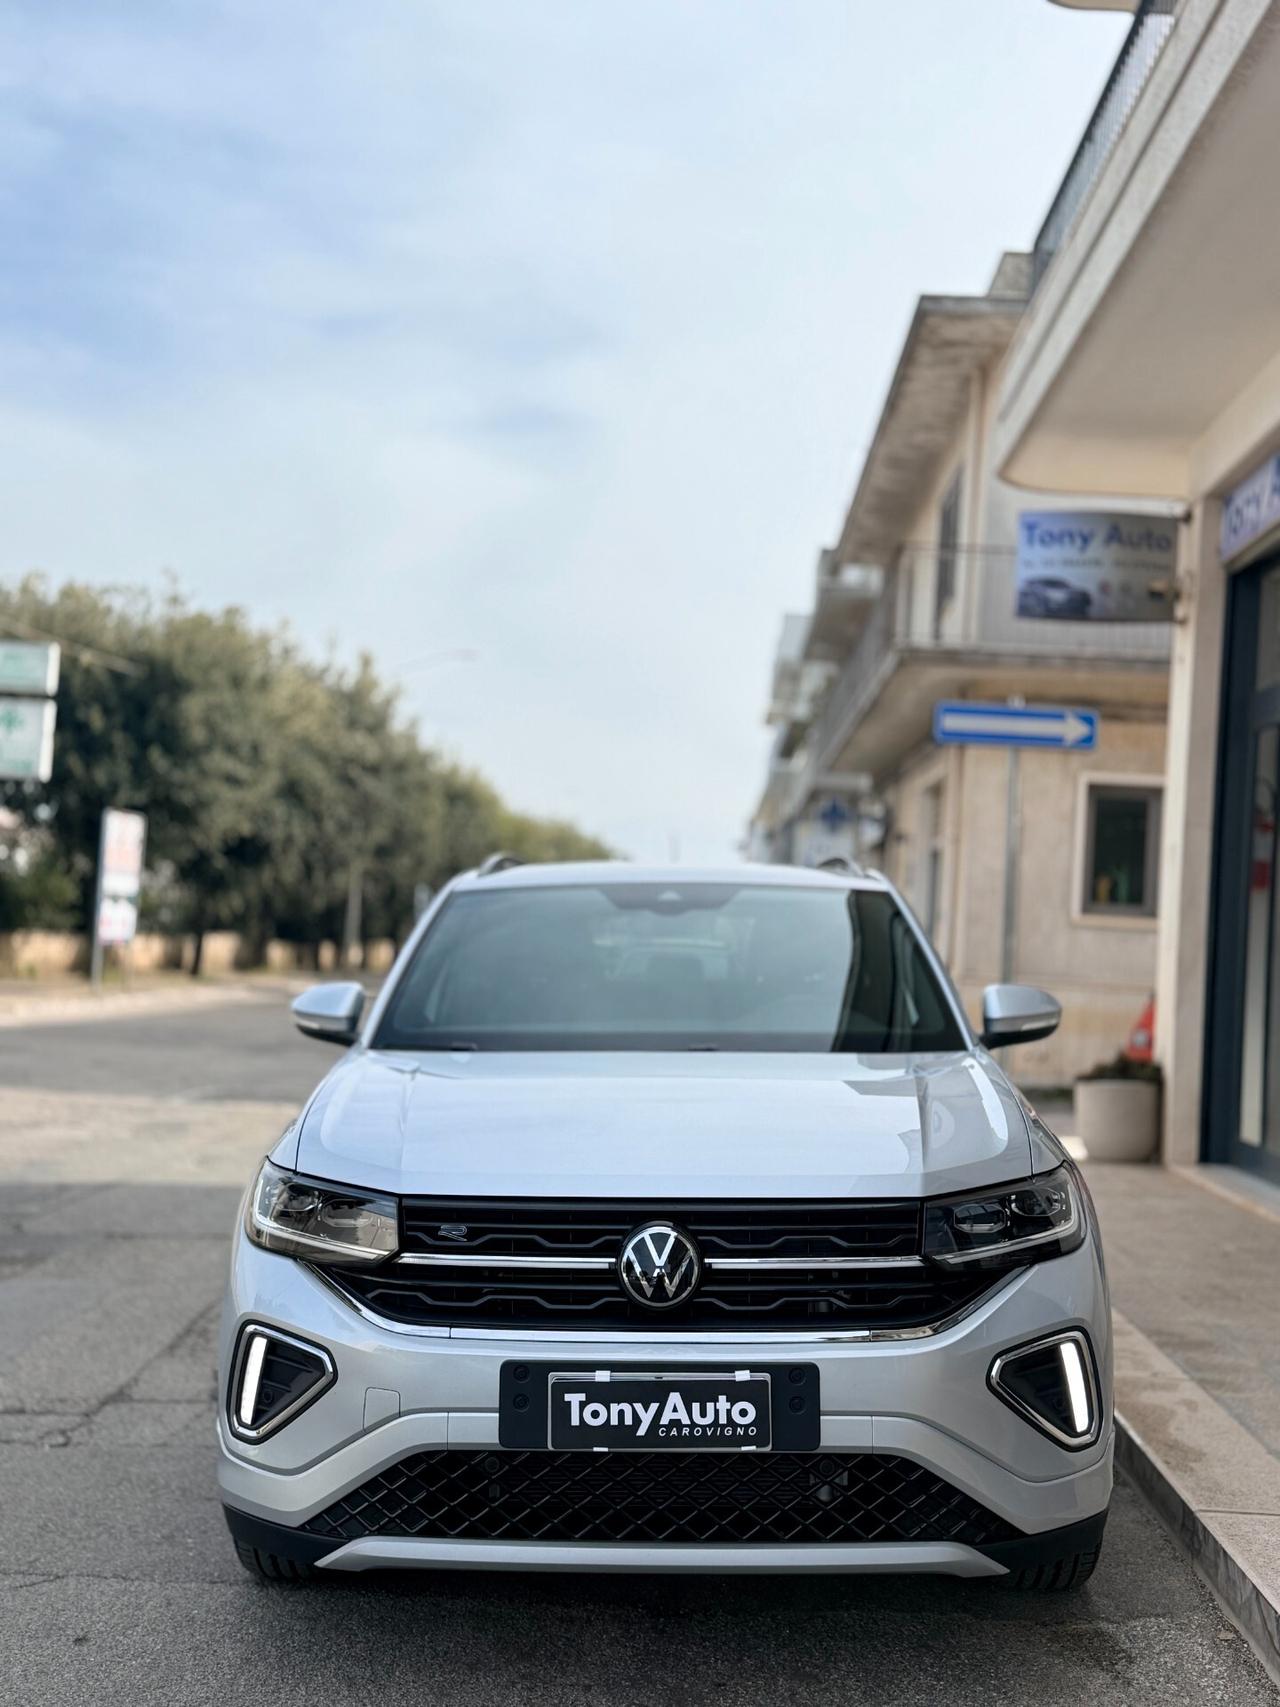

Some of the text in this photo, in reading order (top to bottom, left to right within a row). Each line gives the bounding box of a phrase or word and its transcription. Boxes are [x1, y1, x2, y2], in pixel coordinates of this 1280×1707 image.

[1024, 520, 1171, 553] Tony Auto
[658, 1427, 757, 1437] CAROVIGNO
